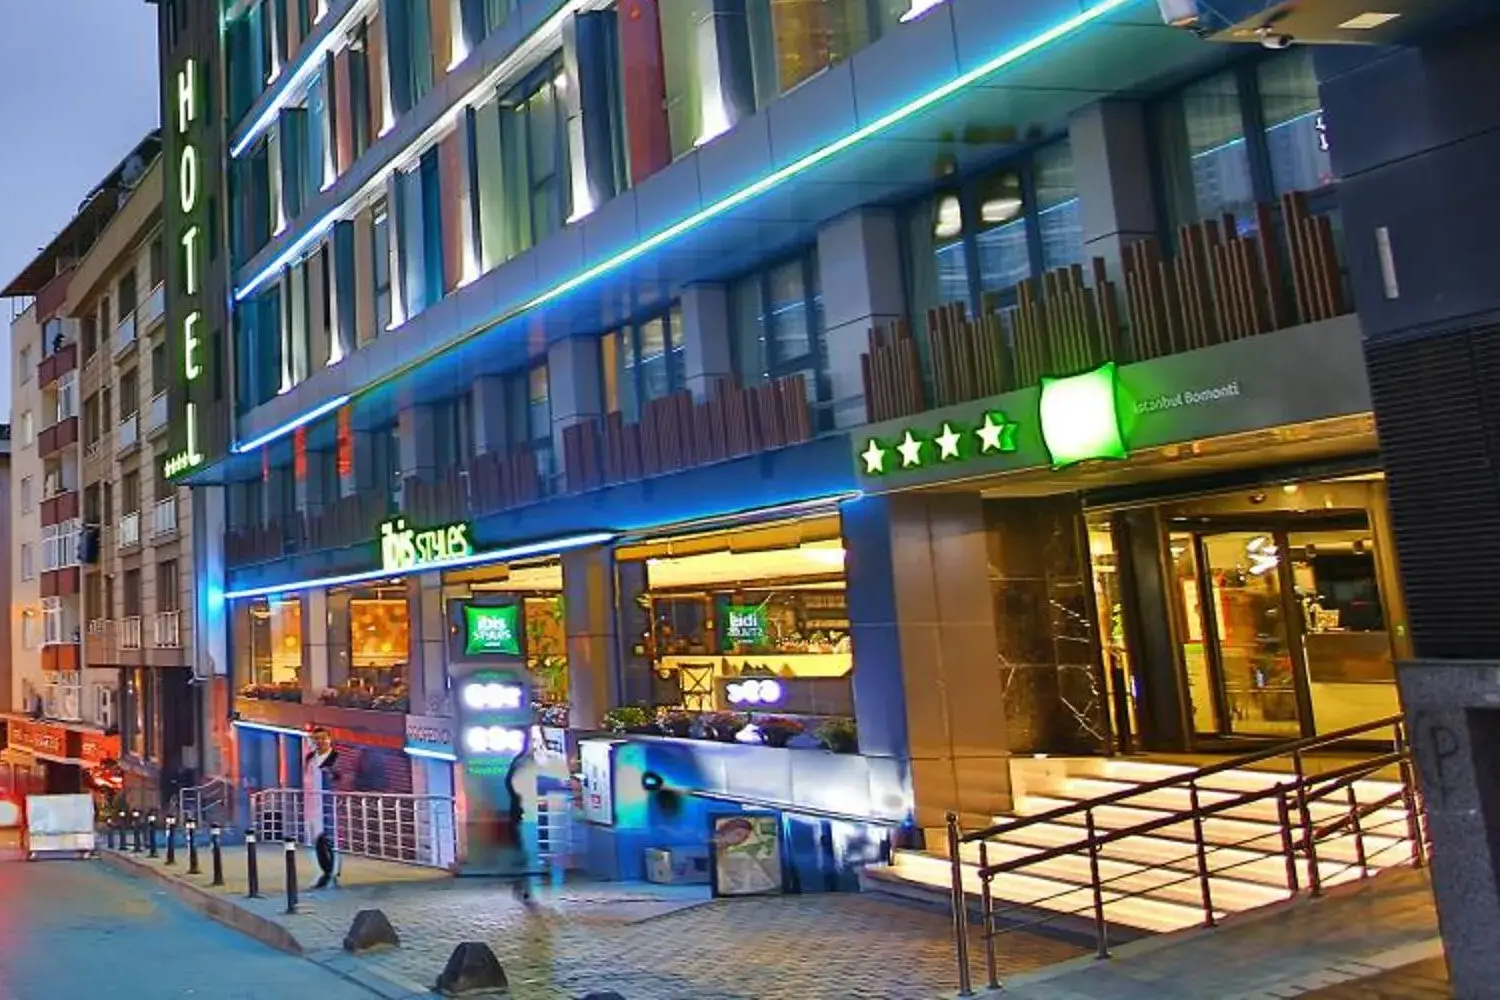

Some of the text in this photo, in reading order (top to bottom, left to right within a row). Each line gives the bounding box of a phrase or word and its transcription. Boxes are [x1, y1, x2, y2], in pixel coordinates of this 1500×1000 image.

[177, 57, 204, 466] HOTEL
[1183, 381, 1240, 404] Bomonti
[381, 519, 415, 571] ibis
